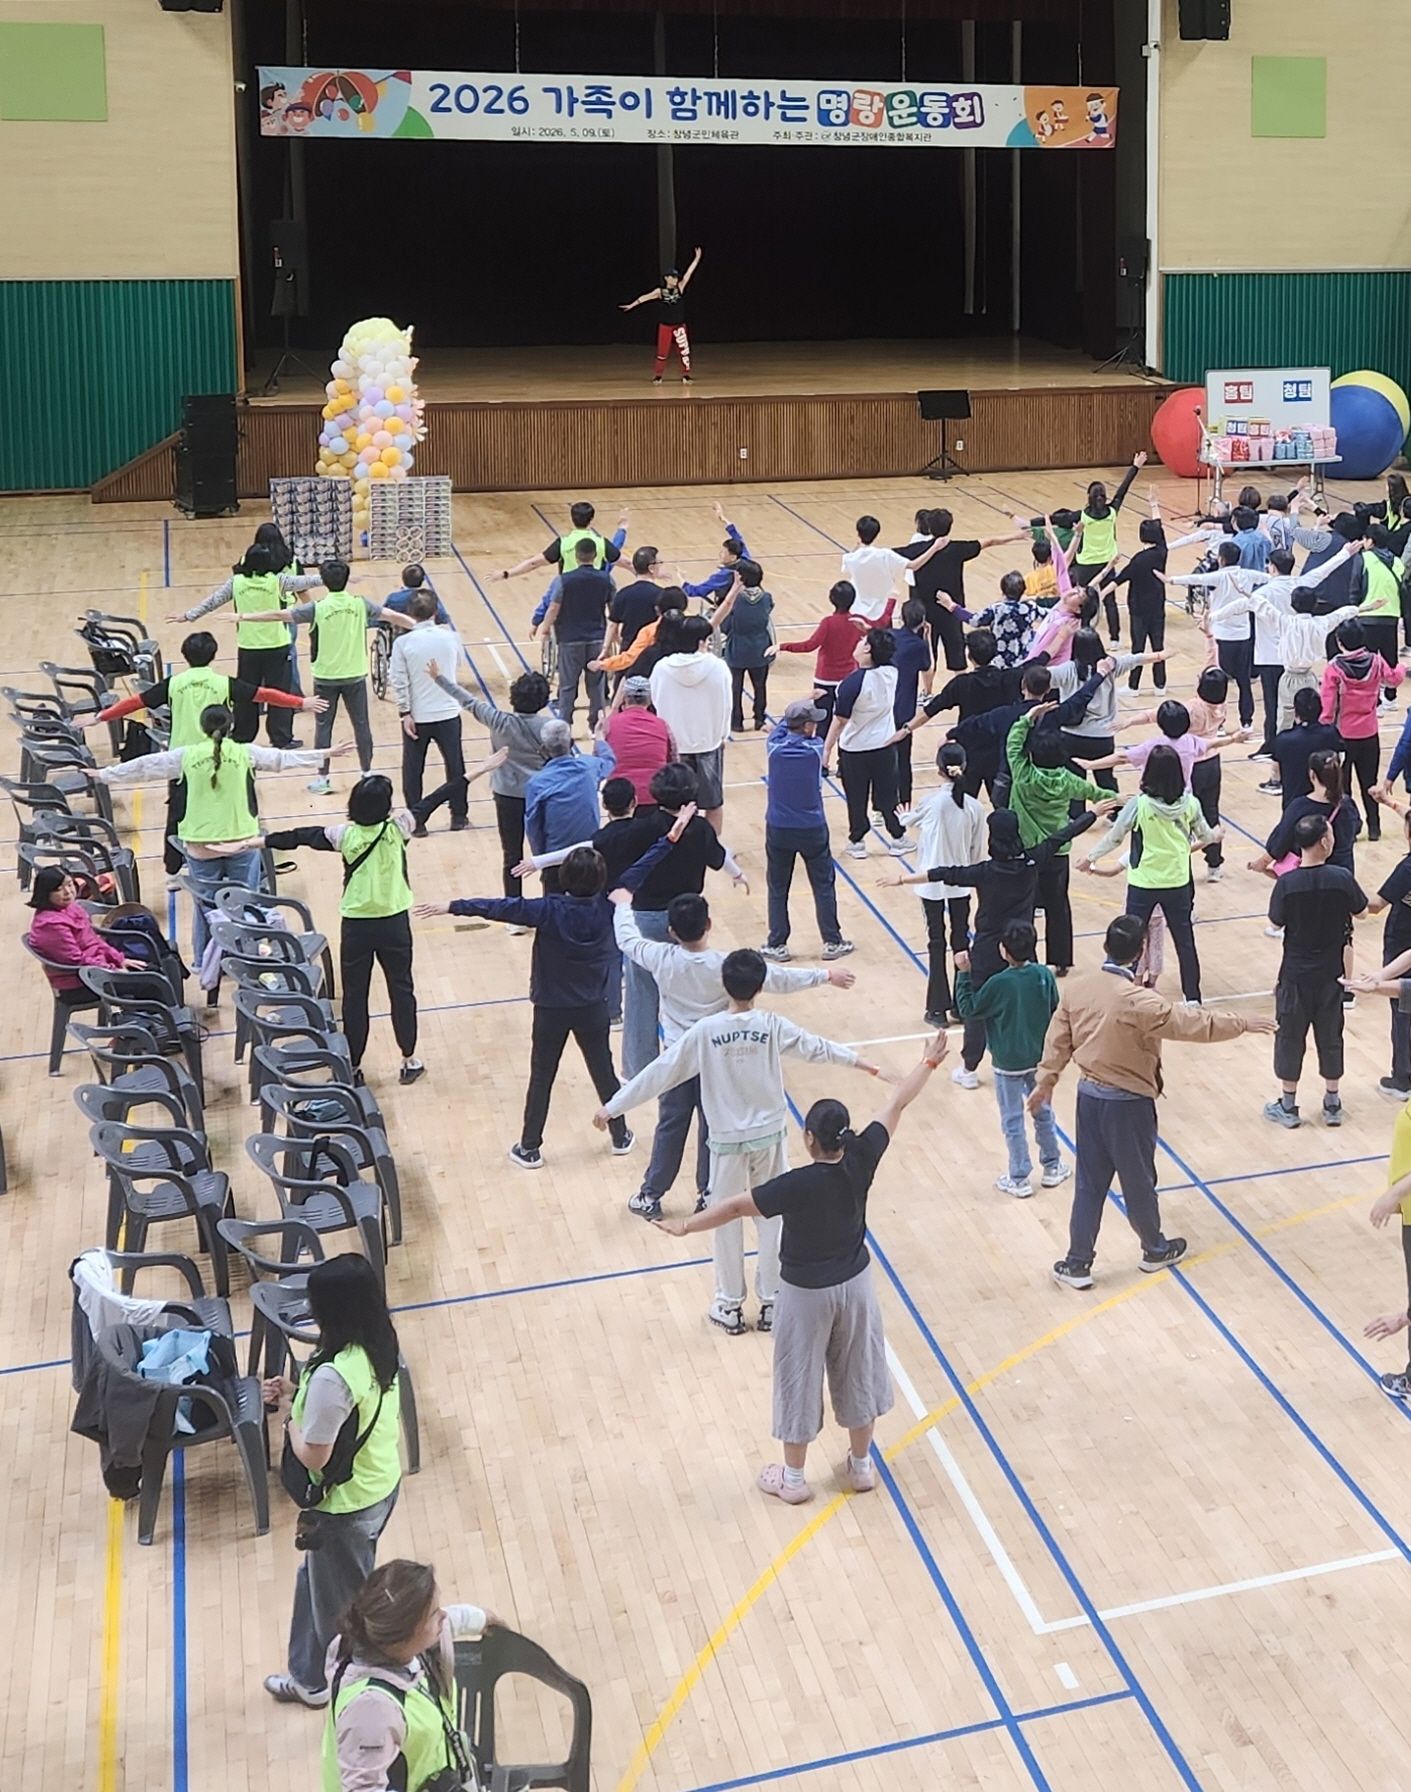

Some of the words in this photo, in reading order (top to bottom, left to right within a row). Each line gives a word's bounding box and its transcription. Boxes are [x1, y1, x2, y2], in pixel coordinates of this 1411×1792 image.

[428, 83, 530, 115] 2026
[542, 85, 652, 119] 가족이
[666, 86, 810, 123] 함께하는
[818, 90, 984, 128] 명랑운동회
[673, 129, 739, 140] 창녕군민체육관
[833, 131, 932, 142] 창녕군장애인종합복지관
[1283, 383, 1312, 399] 청팀
